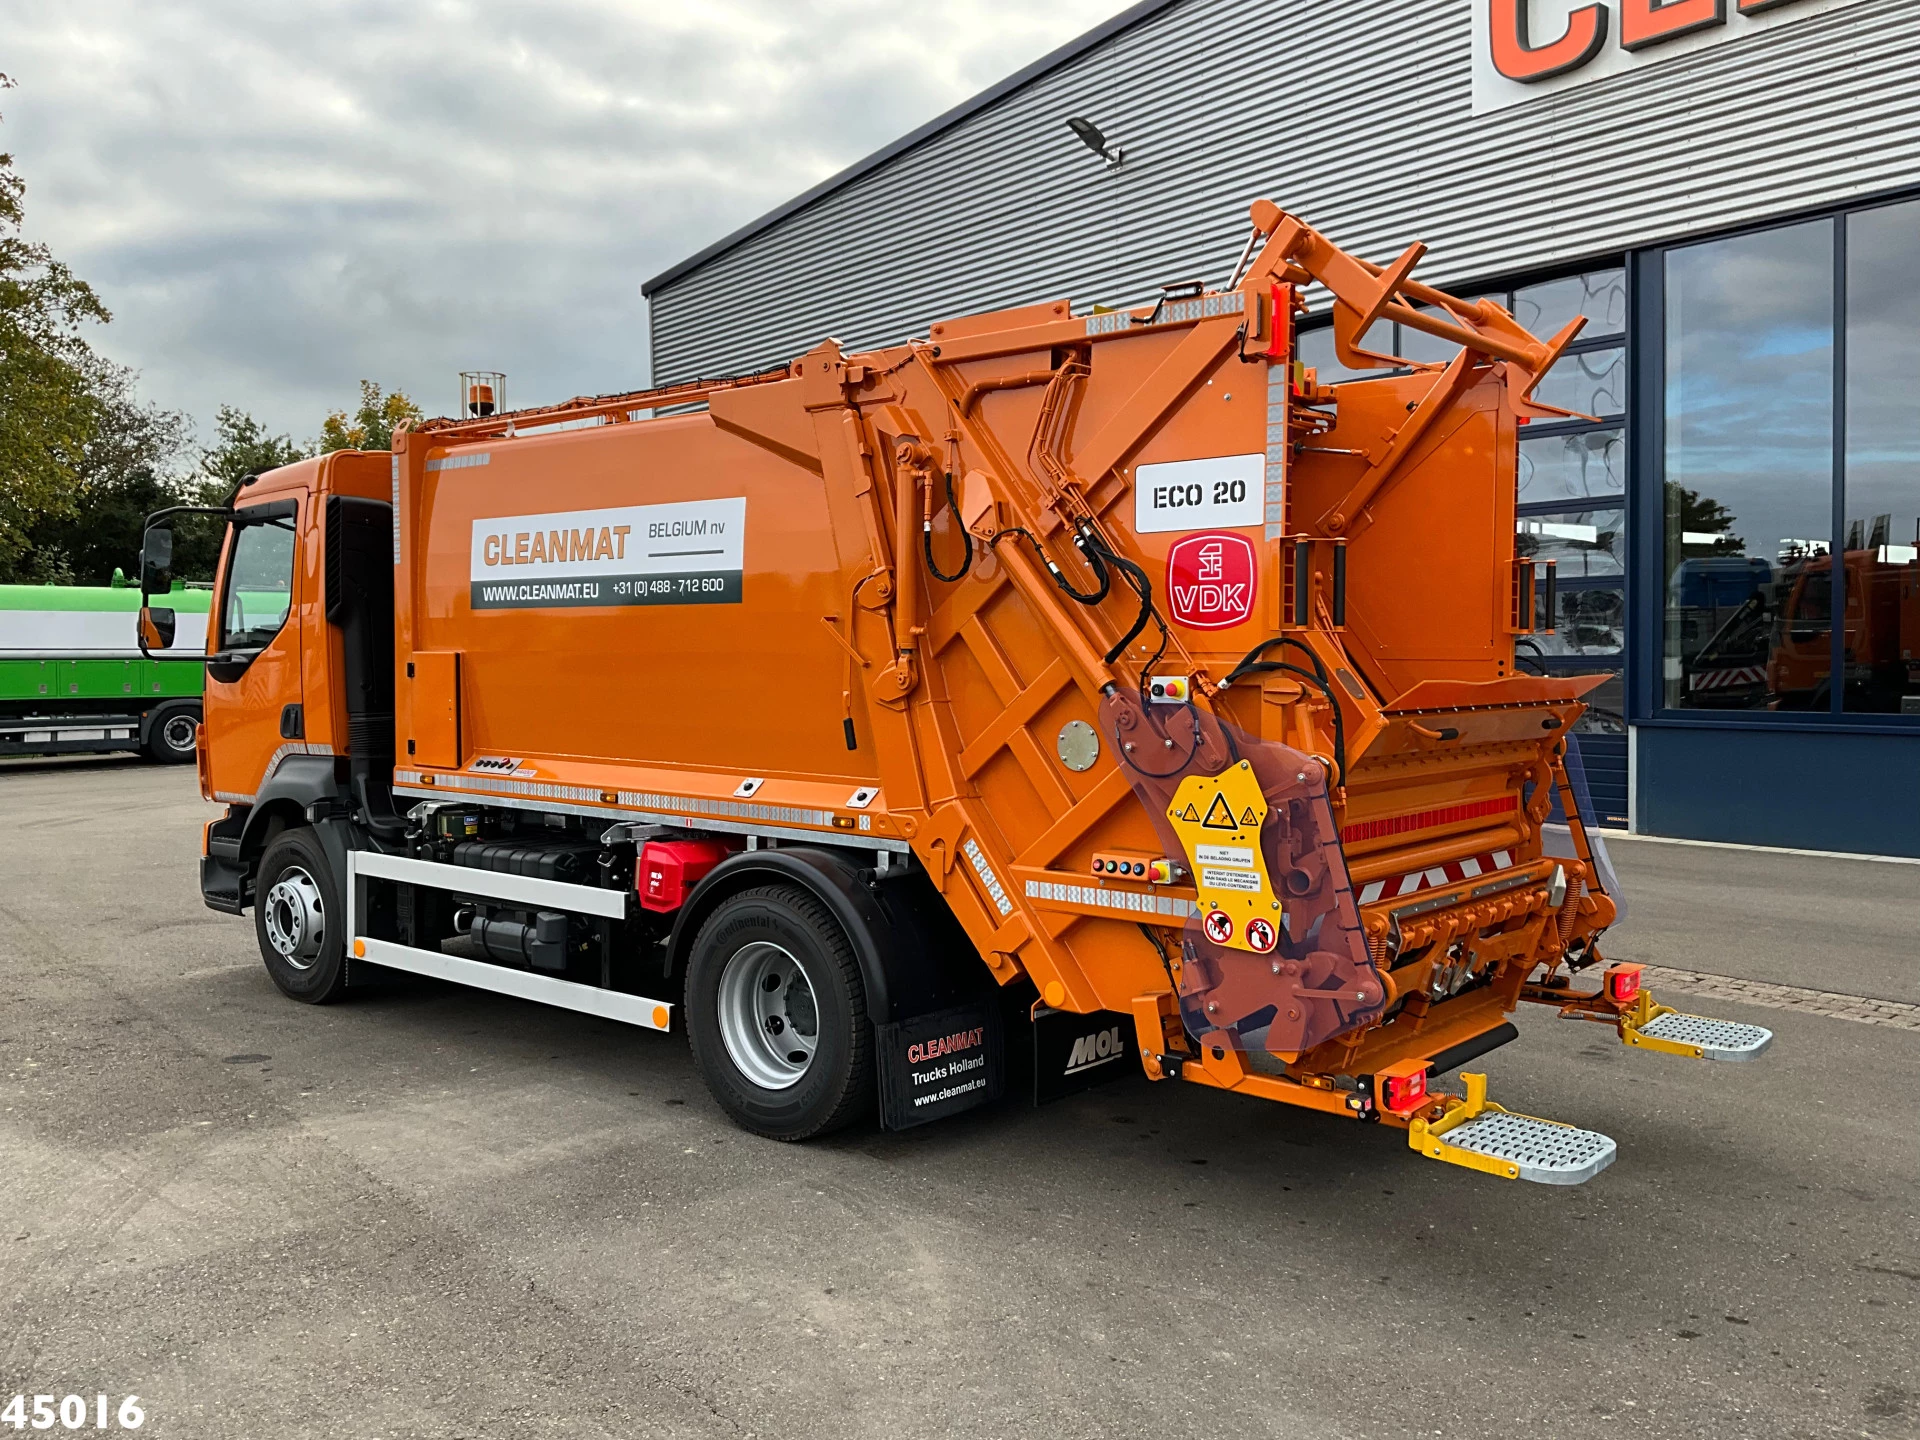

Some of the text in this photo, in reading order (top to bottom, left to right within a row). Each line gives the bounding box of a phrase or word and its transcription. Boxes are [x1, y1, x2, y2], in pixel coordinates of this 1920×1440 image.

[1153, 480, 1246, 509] ECO 20
[648, 520, 726, 538] BELGIUM nv
[483, 525, 631, 567] CLEANMAT
[483, 583, 599, 601] WWW.CLEANMAT.EU
[612, 582, 631, 594] +31
[634, 580, 648, 596] (0)
[649, 580, 671, 593] 488
[701, 578, 724, 591] 600
[1174, 583, 1246, 613] VDK
[715, 916, 770, 945] Continental
[907, 1027, 984, 1064] CLEANMAT
[1066, 1026, 1124, 1068] MOL
[912, 1054, 984, 1085] Trucks Holland
[914, 1077, 986, 1107] www.cleanmat.eu
